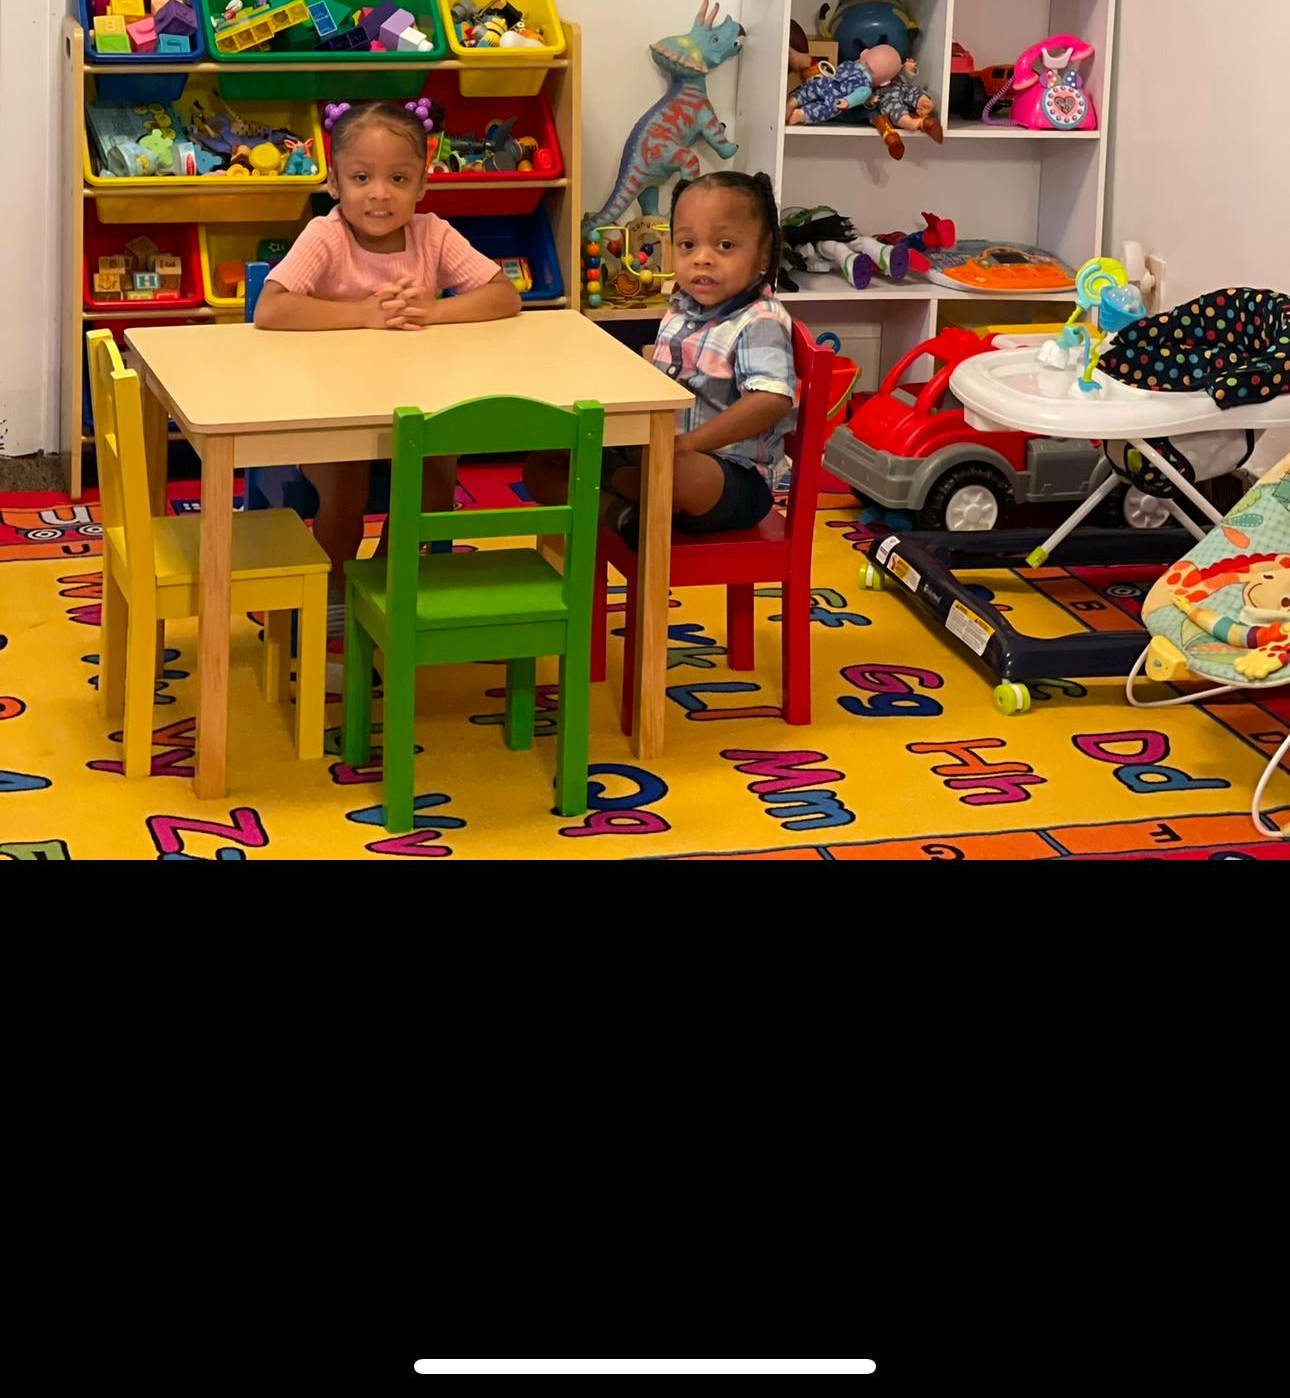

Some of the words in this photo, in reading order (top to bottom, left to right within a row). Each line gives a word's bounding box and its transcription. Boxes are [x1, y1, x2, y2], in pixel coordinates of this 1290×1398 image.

[838, 662, 944, 717] Gg
[719, 748, 857, 832] Mm
[905, 737, 1048, 806] Hh
[1071, 729, 1231, 794] Dd
[1148, 822, 1182, 844] F
